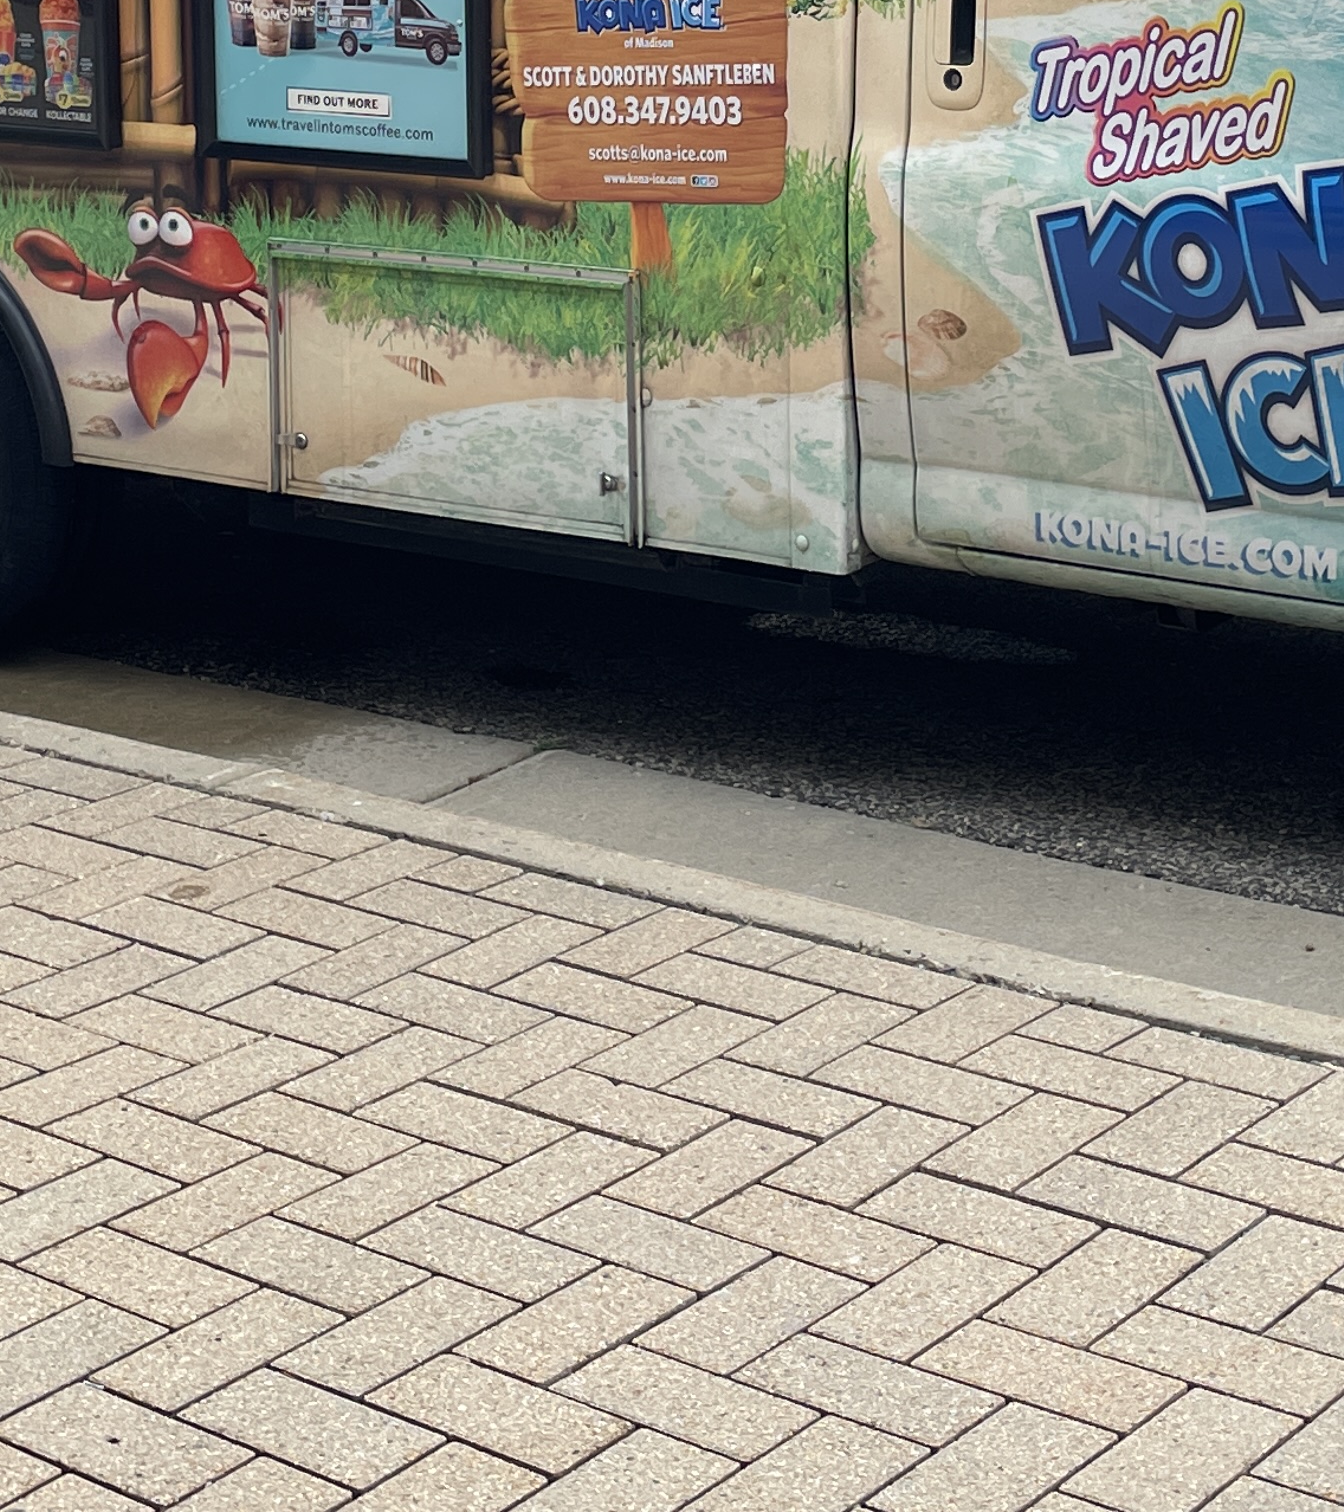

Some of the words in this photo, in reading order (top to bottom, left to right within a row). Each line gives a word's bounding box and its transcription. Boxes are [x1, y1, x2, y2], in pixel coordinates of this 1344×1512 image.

[229, 0, 253, 15] TOM
[291, 4, 316, 18] OM'S
[624, 37, 634, 48] of
[635, 37, 674, 48] Madison
[1033, 4, 1241, 118] Tropical
[523, 66, 570, 87] SCOTT
[576, 65, 587, 87] &
[590, 64, 669, 86] DOROTHY
[672, 63, 775, 85] SANFTLEBEN
[8, 106, 39, 118] CHANGE
[297, 93, 321, 107] FIND
[323, 95, 345, 108] OUT
[347, 97, 379, 110] MORE
[567, 95, 742, 126] 608.347.9403
[246, 115, 434, 141] www.travelintomscoffee.com
[1089, 75, 1292, 182] Shaved
[588, 144, 727, 163] scotts@kona-ice.com
[603, 173, 686, 186] www.kona-ice.com
[1035, 511, 1339, 582] KONA-ICE.COM
